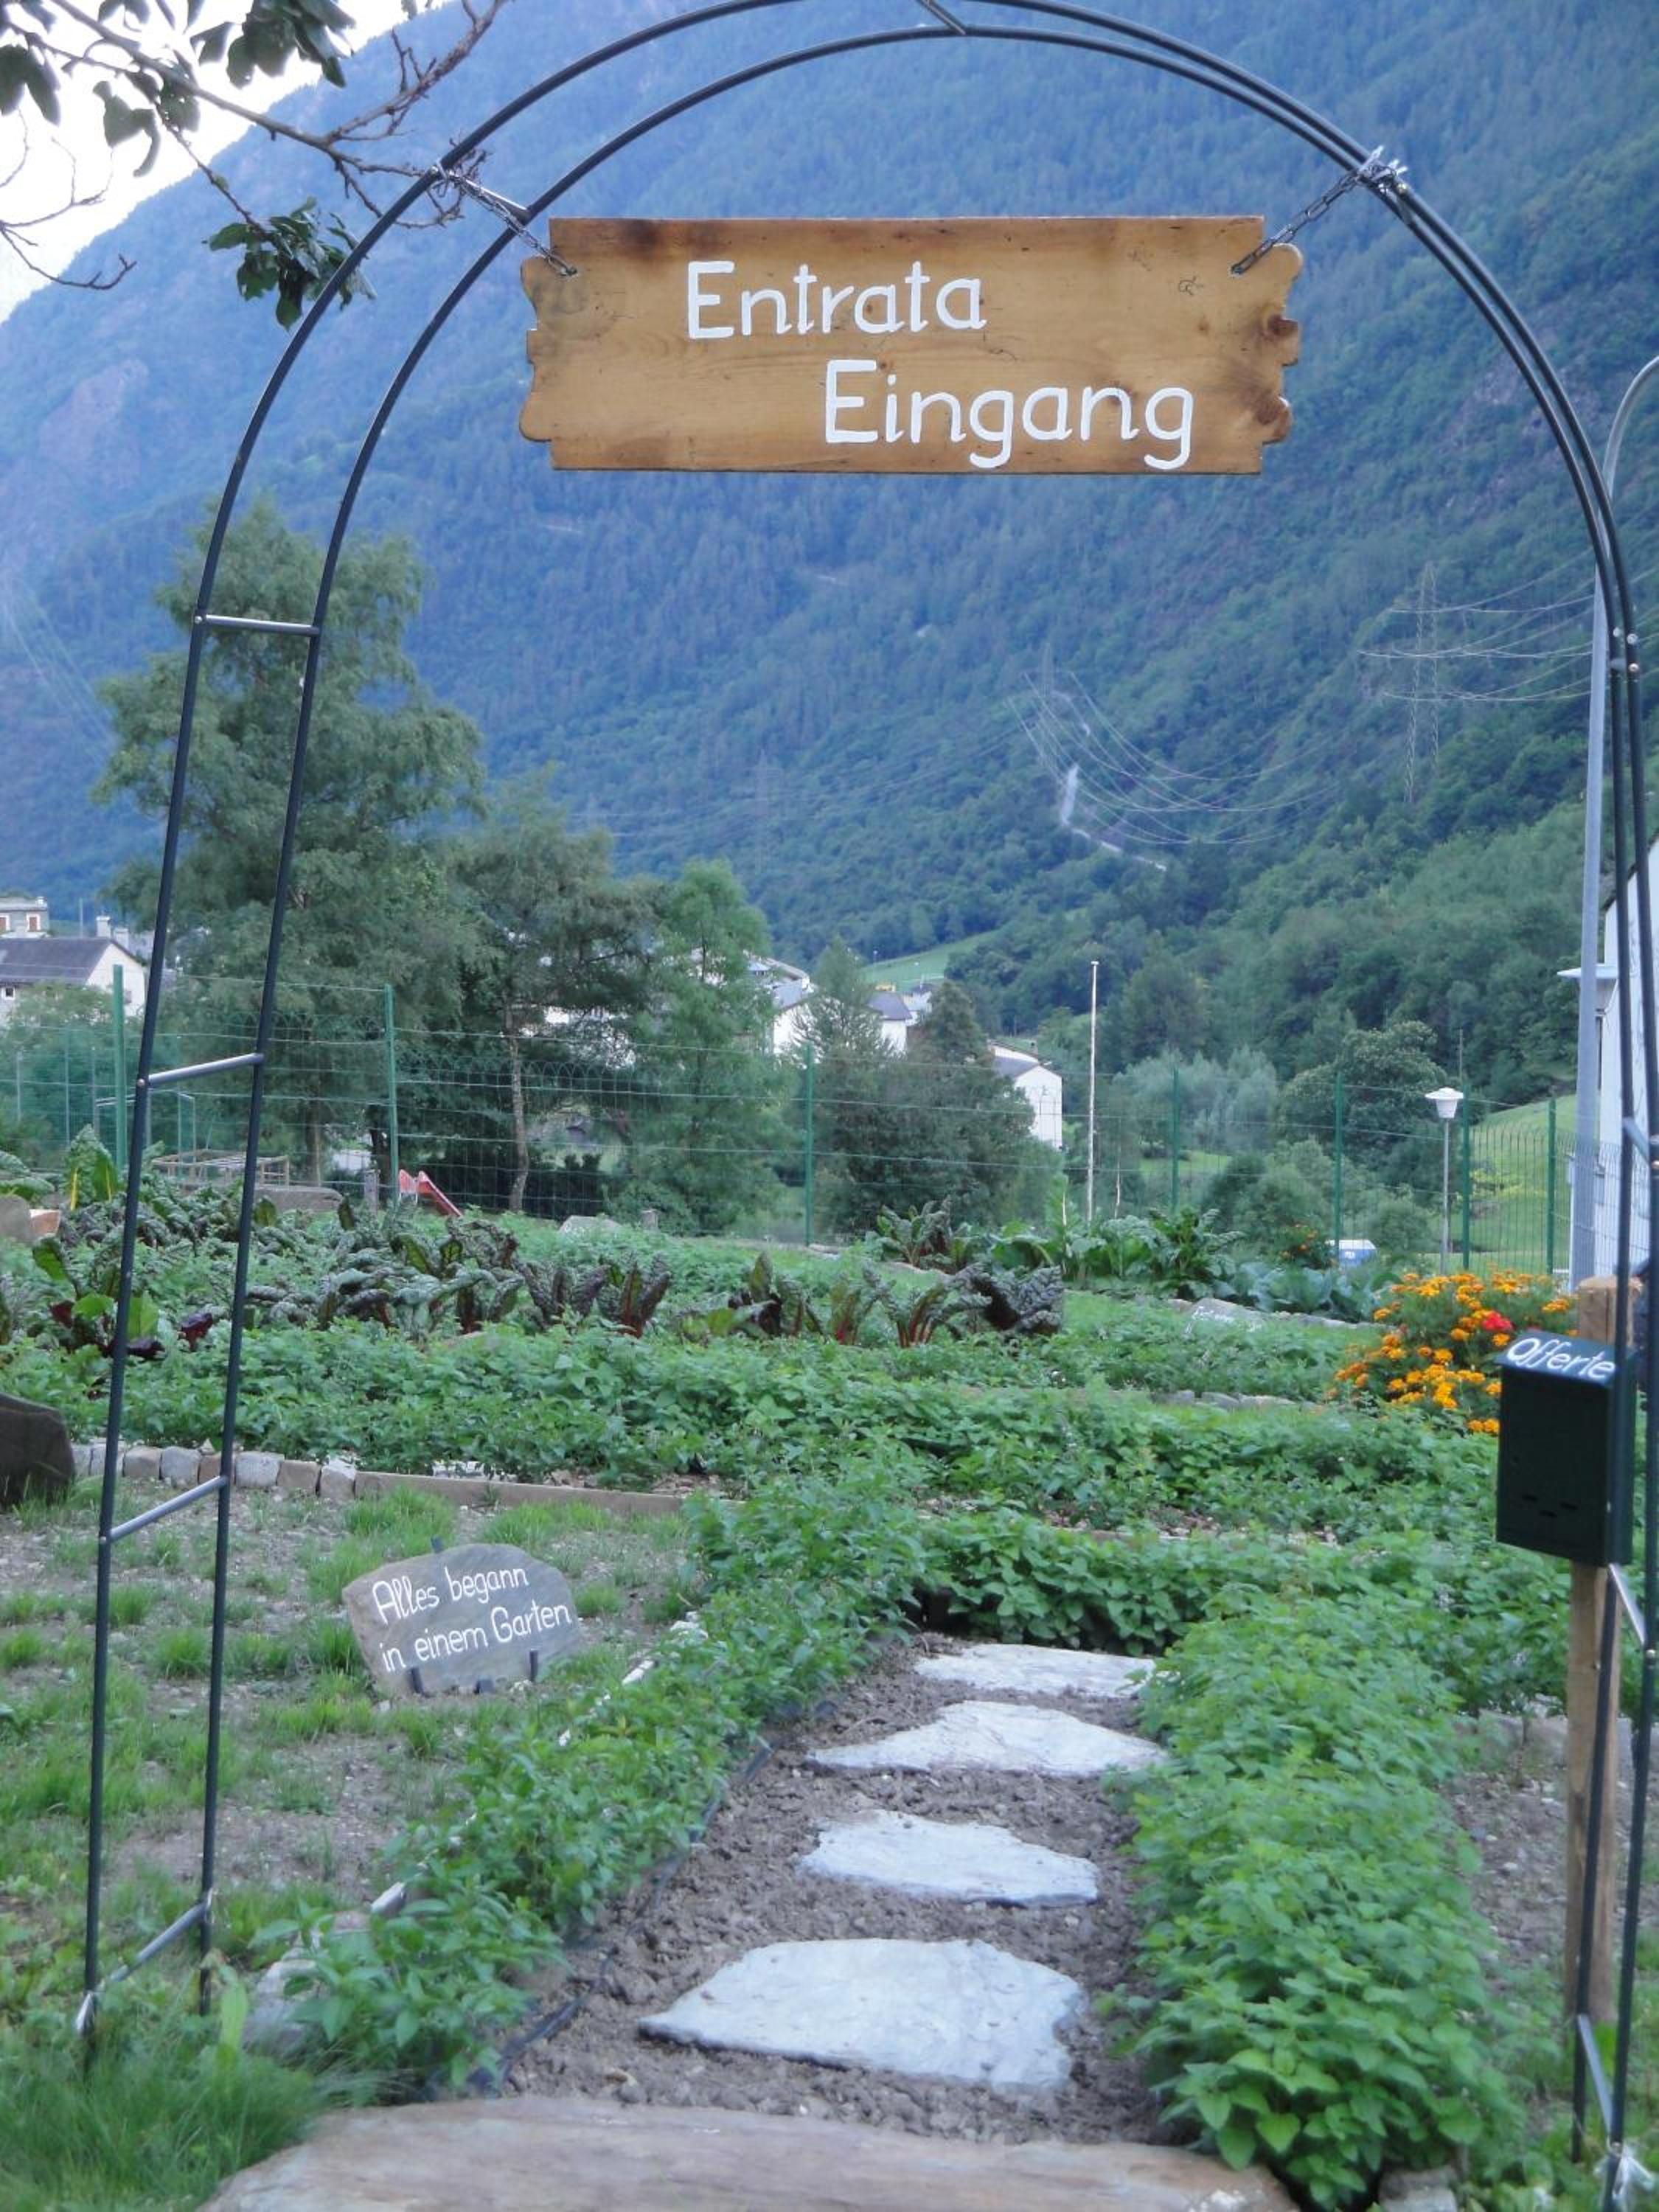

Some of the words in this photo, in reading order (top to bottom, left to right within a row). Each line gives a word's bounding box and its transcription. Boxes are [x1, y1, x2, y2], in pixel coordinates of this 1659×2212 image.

[686, 260, 988, 340] Entrata
[824, 358, 1195, 470] Eingang
[1506, 1337, 1615, 1378] Offerte
[372, 1575, 440, 1625] Alles
[444, 1566, 529, 1604] begann
[379, 1643, 406, 1672] in
[414, 1627, 489, 1661] einem
[490, 1600, 572, 1643] Garten
